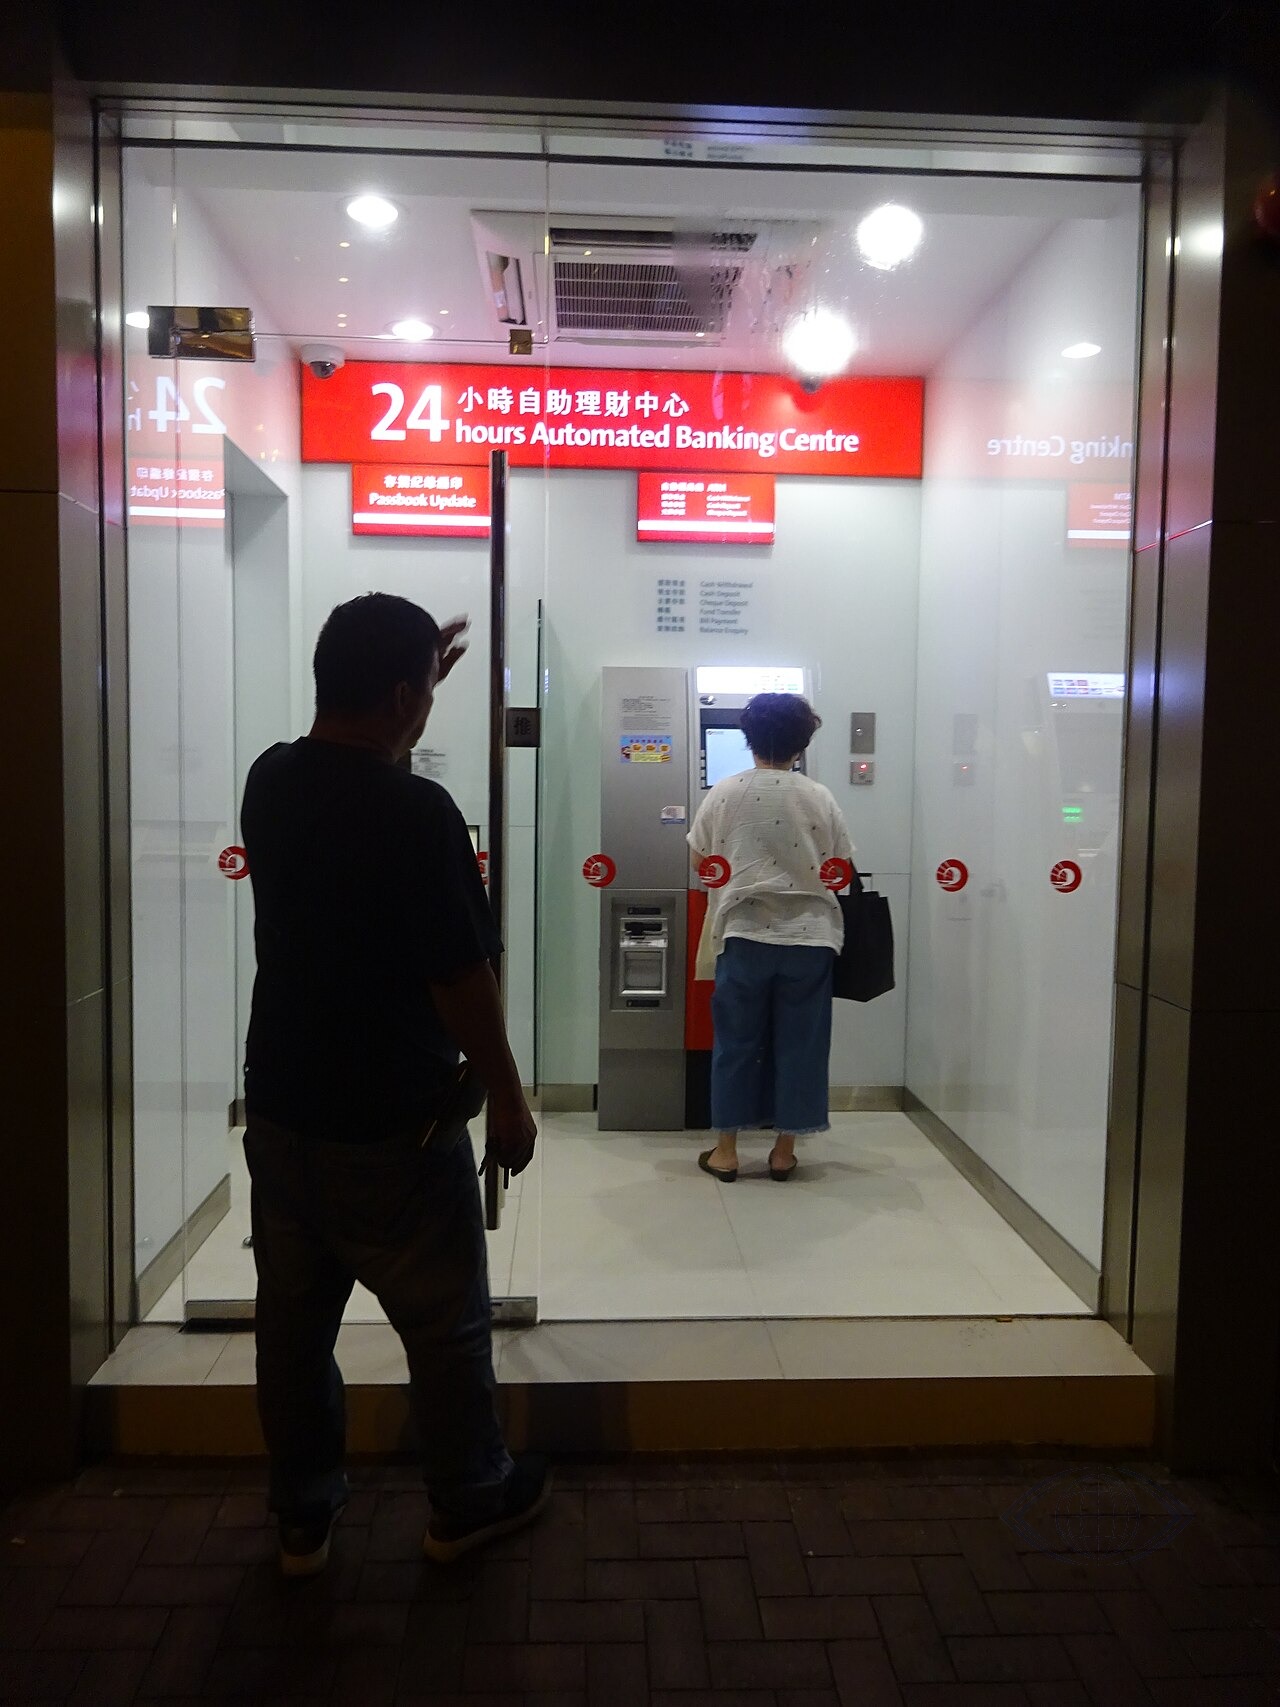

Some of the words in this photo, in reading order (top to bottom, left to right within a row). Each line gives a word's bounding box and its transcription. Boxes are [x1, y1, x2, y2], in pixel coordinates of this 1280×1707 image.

[370, 382, 450, 442] 24
[457, 386, 690, 418] 小時自助理財中心
[455, 418, 525, 444] hours
[530, 421, 670, 449] Automated
[675, 425, 776, 457] Banking
[778, 428, 860, 452] Centre
[368, 492, 429, 507] Passbook
[429, 494, 477, 511] Update
